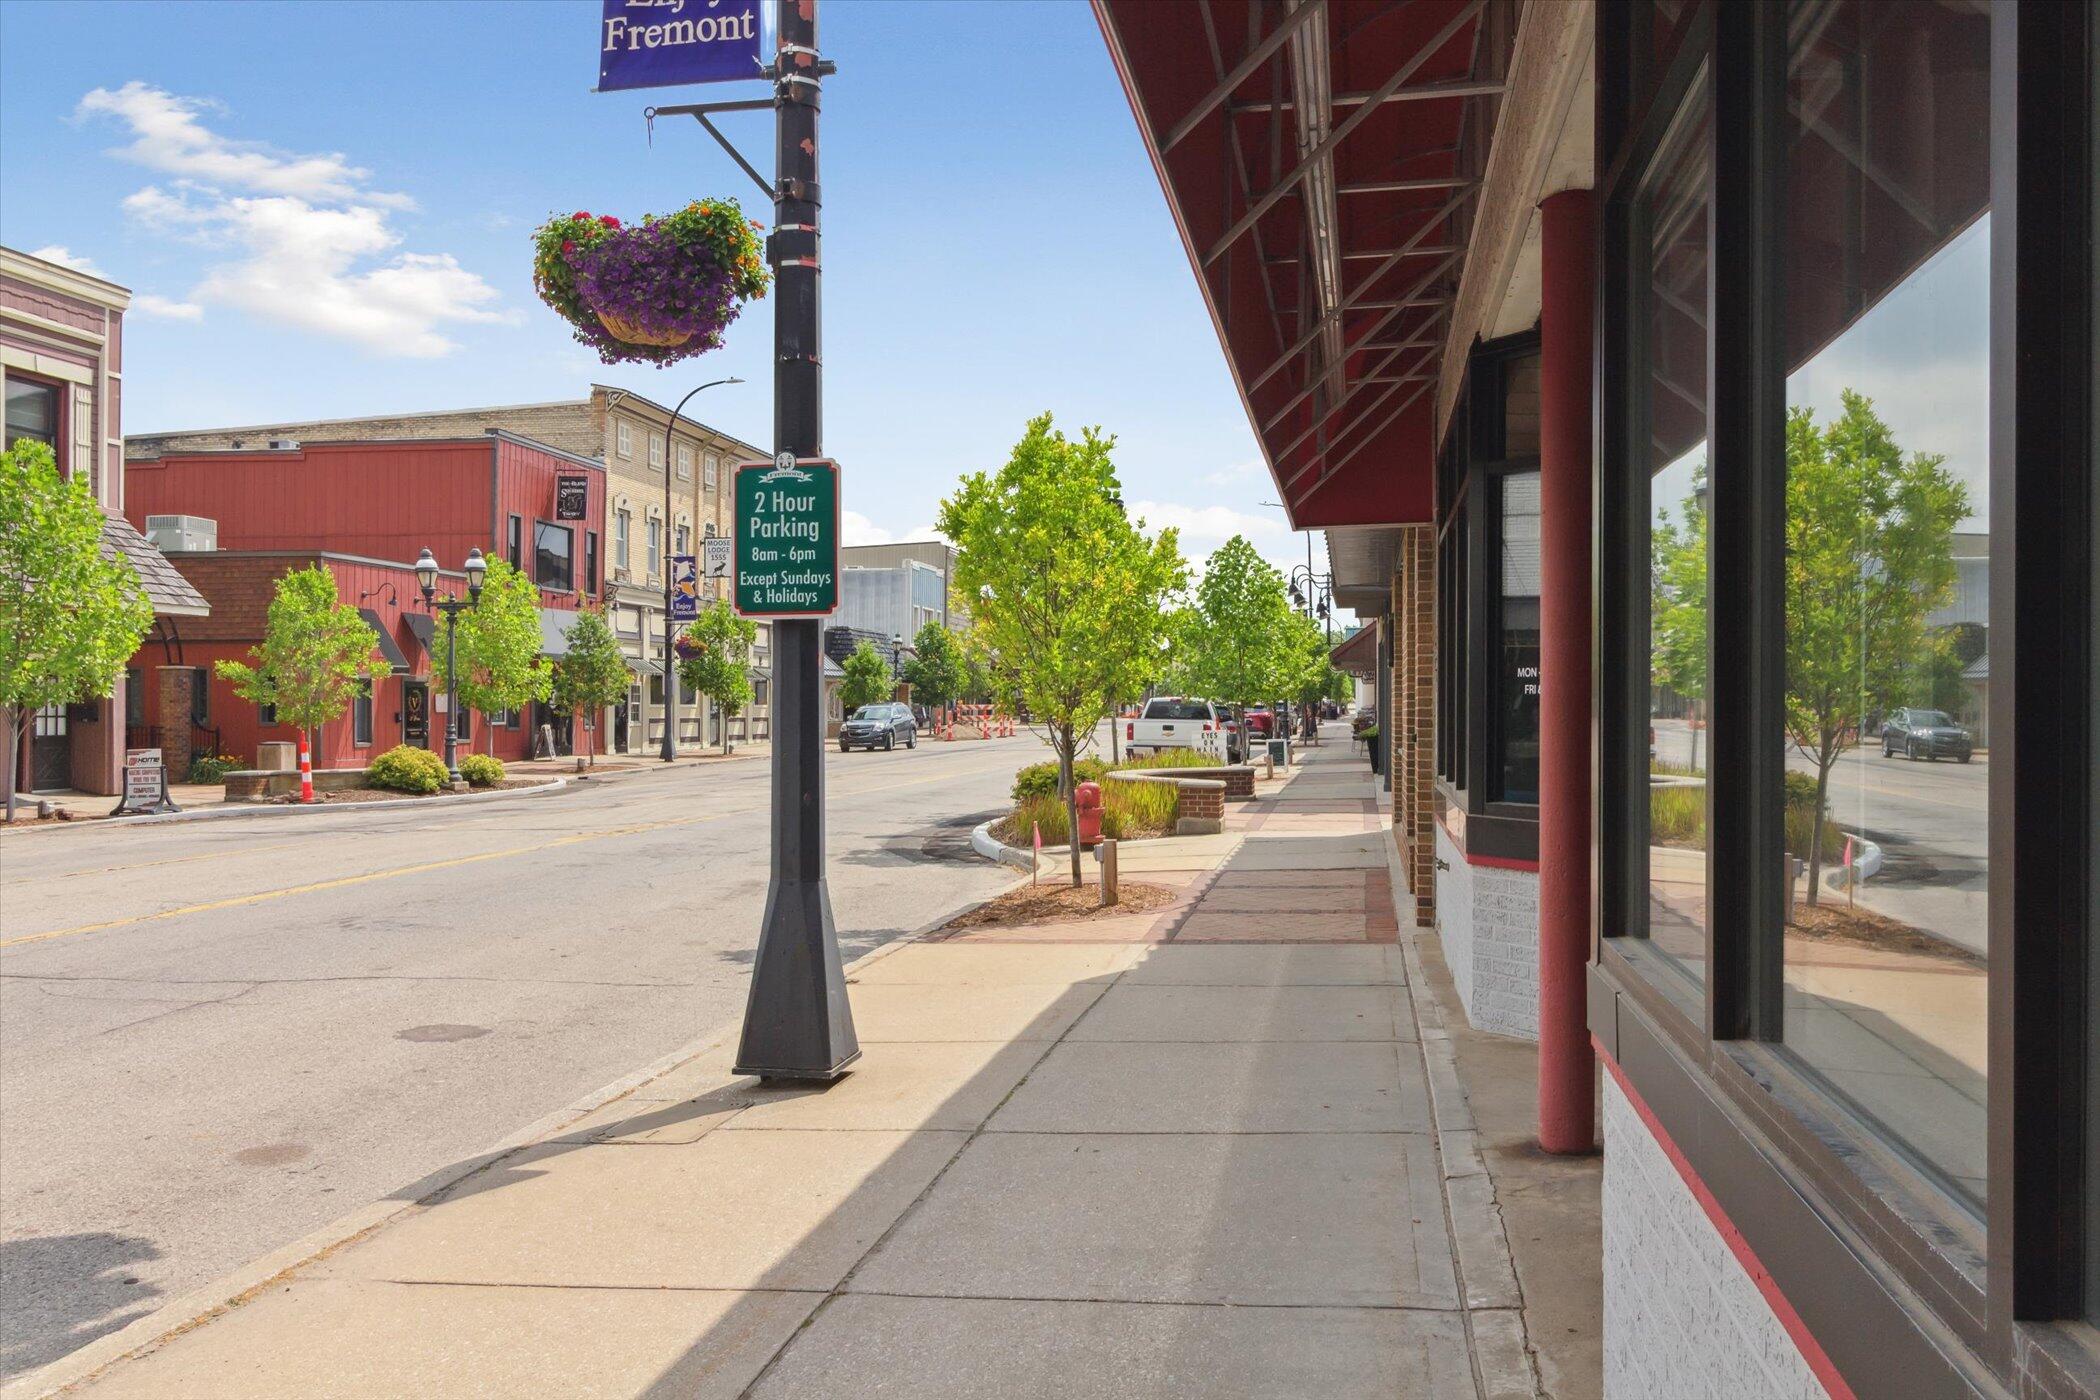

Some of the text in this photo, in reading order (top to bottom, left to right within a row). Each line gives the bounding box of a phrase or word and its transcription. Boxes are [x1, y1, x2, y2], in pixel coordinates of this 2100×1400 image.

[603, 9, 755, 51] Fremont
[754, 491, 816, 513] 2 Hour
[750, 514, 819, 542] Parking
[752, 546, 778, 561] 8am
[789, 546, 816, 564] 6pm
[740, 569, 831, 588] Except Sundays
[753, 587, 818, 606] & Holidays
[1517, 667, 1537, 678] MON
[1524, 684, 1537, 694] FRI
